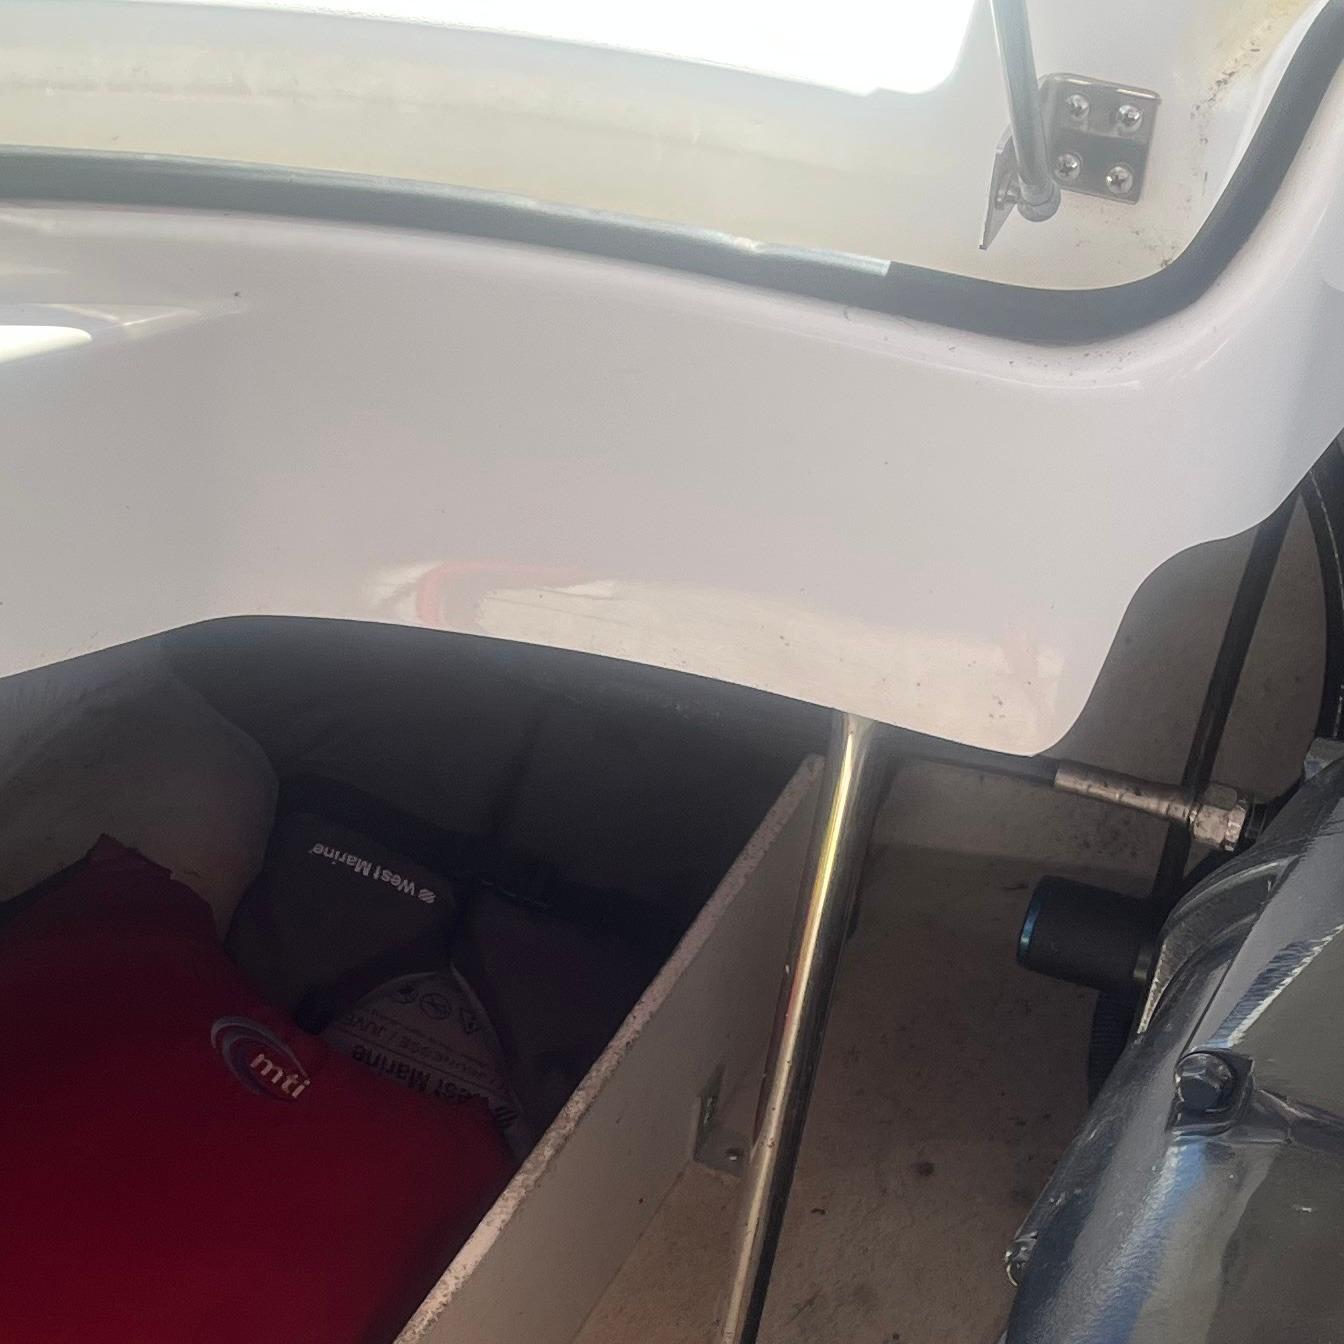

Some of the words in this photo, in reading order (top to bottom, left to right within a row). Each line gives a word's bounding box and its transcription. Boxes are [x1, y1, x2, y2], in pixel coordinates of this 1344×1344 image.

[310, 842, 373, 877] Marine
[372, 864, 416, 897] West
[249, 1053, 311, 1099] mti
